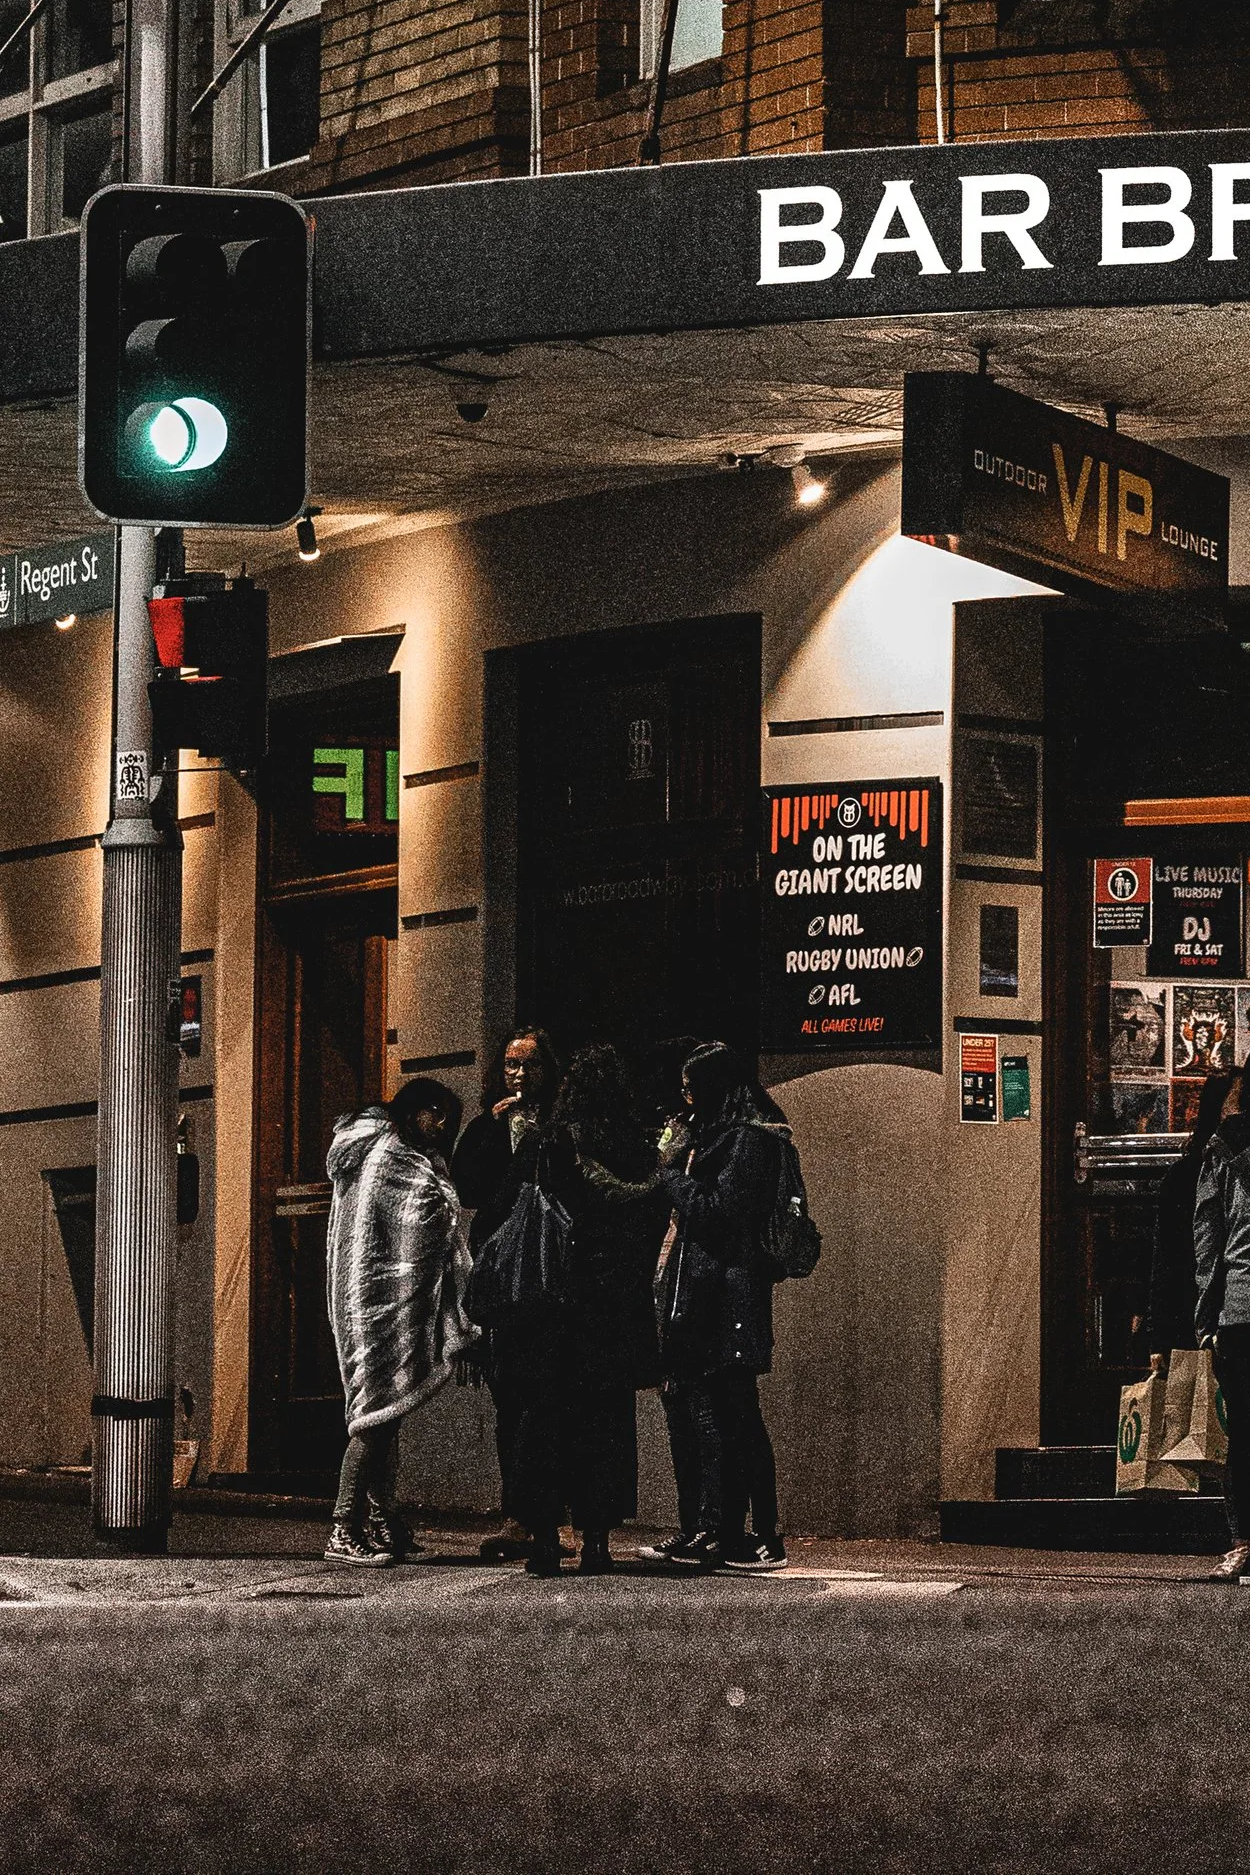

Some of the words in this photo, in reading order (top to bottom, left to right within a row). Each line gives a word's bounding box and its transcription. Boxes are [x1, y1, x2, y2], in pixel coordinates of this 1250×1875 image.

[757, 174, 1054, 285] BAR
[974, 449, 1048, 495] OUTDOOR
[1052, 443, 1154, 561] VIP
[1161, 521, 1218, 561] LOUNGE
[21, 557, 76, 601] Regent
[82, 547, 98, 582] St
[813, 836, 842, 862] ON
[848, 833, 885, 860] THE
[775, 868, 841, 896] GIANT
[845, 864, 921, 893] SCREEN
[1155, 866, 1188, 882] LIVE
[1194, 867, 1240, 884] MUSIC
[1172, 887, 1223, 899] THURSDAY
[829, 914, 864, 935] NRL
[1183, 917, 1211, 941] DJ
[787, 949, 842, 973] RUGBY
[846, 947, 904, 969] UNION
[1174, 944, 1192, 955] FRI
[1194, 944, 1203, 955] &
[1205, 944, 1224, 956] SAT
[829, 984, 860, 1005] AFL
[802, 1020, 818, 1033] ALL
[822, 1018, 857, 1032] GAMES
[859, 1017, 883, 1031] LIVE!
[963, 1038, 983, 1047] UNDER
